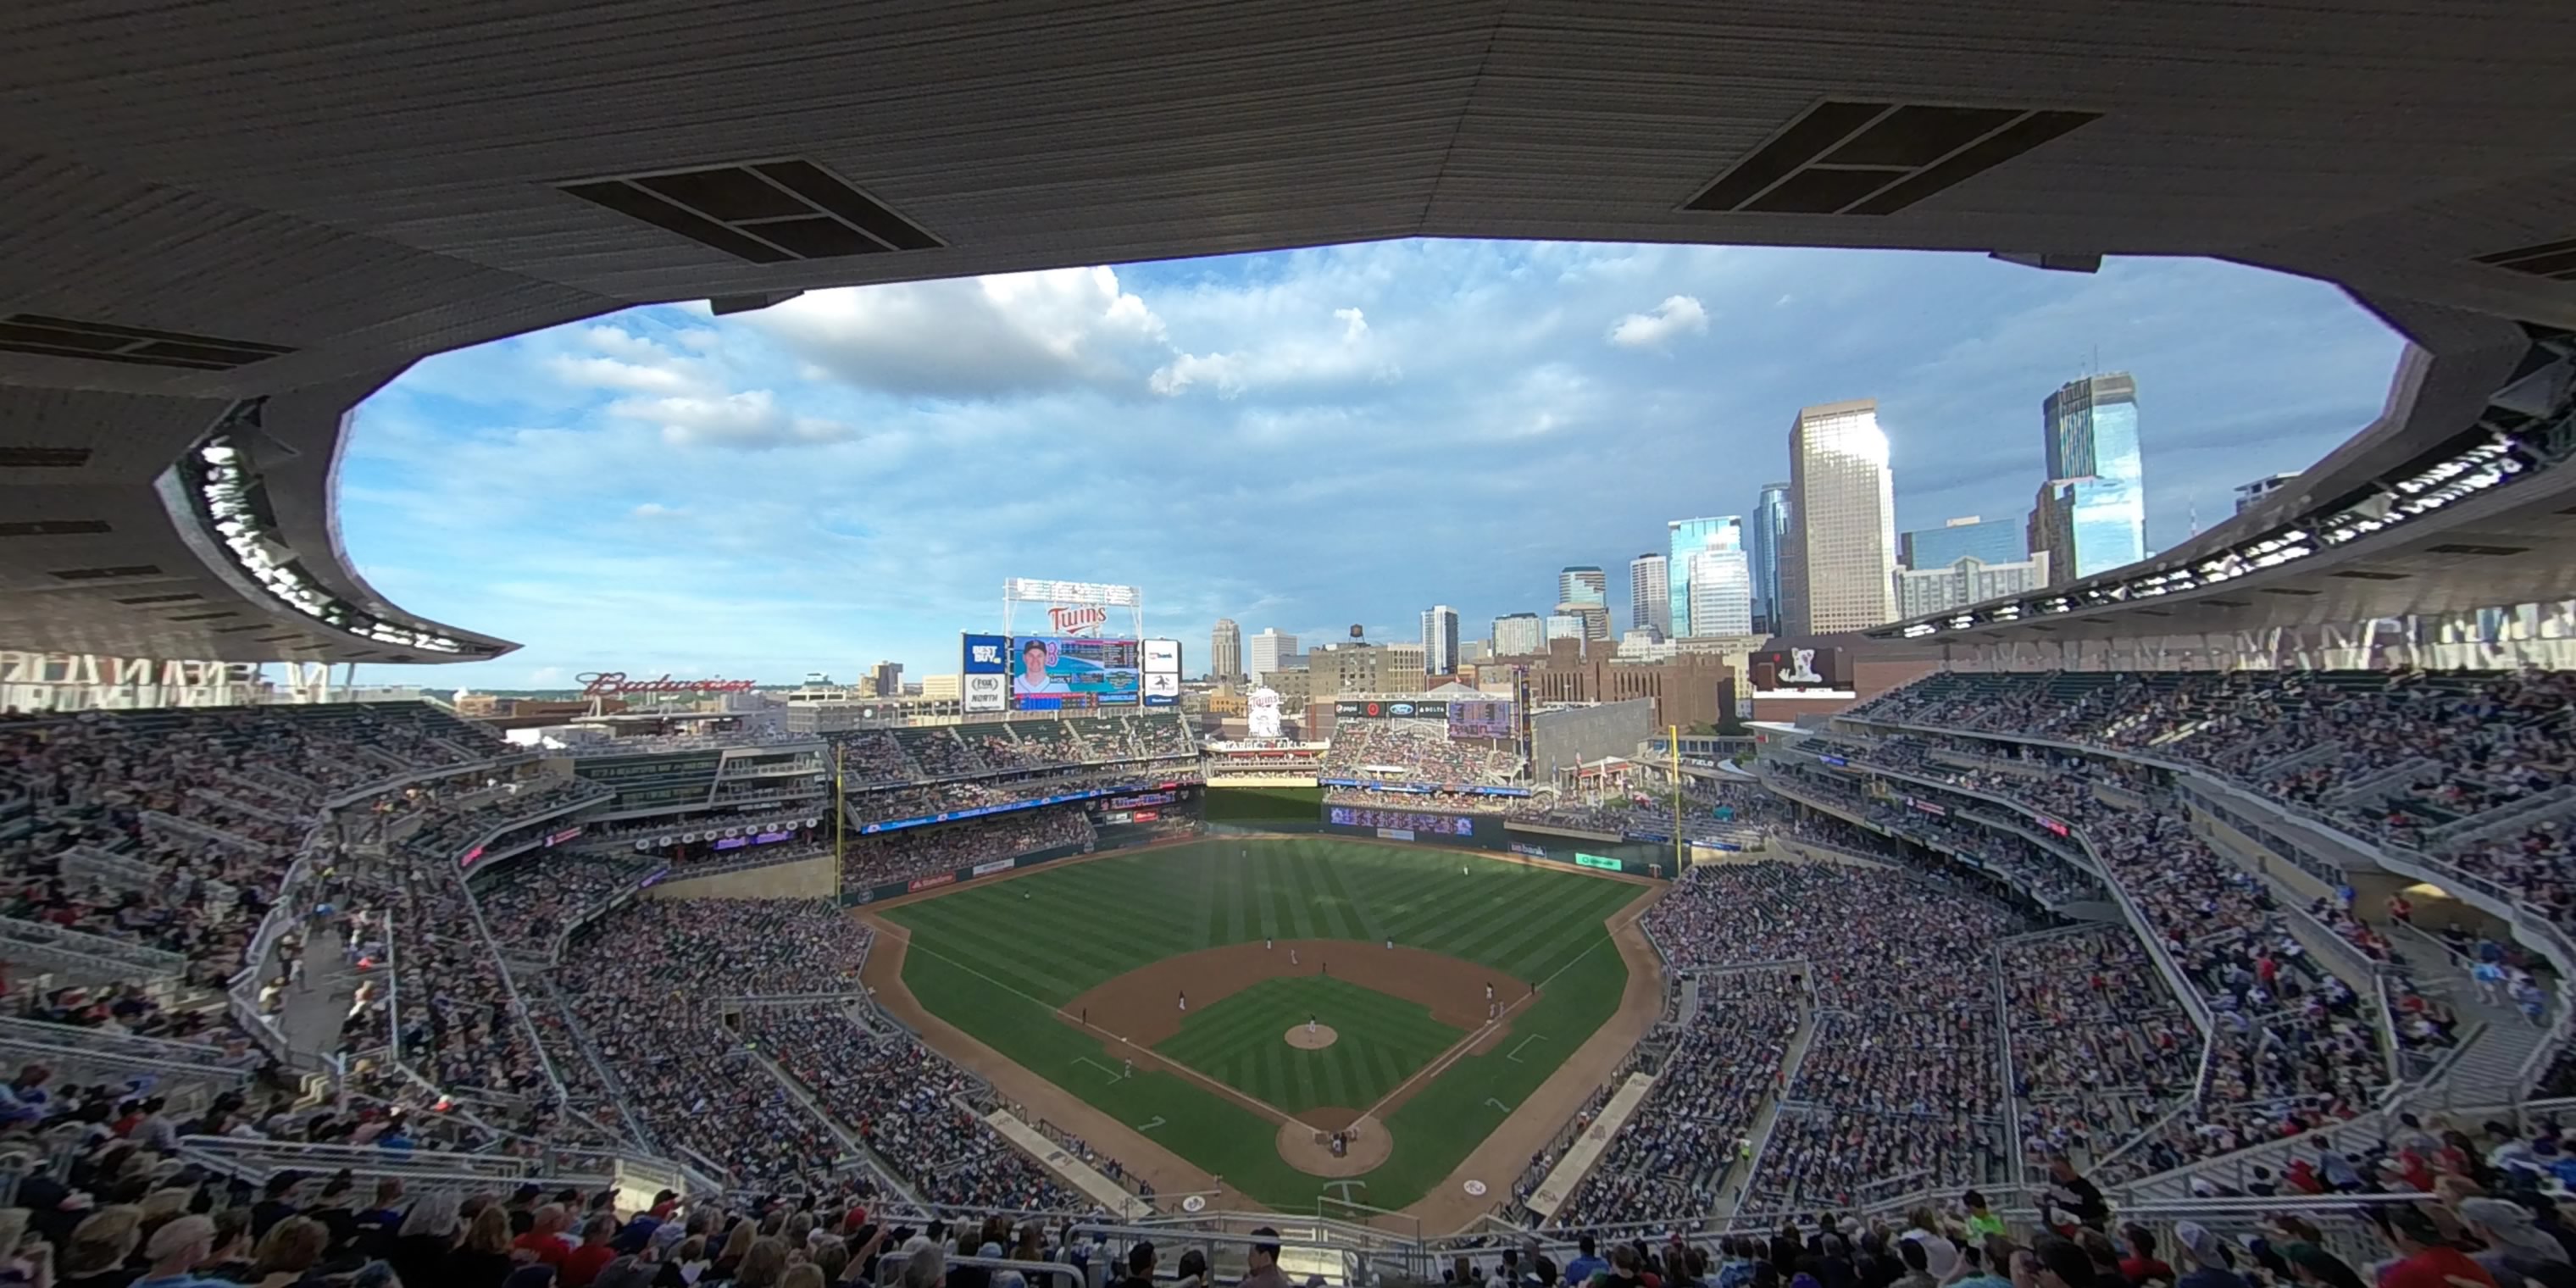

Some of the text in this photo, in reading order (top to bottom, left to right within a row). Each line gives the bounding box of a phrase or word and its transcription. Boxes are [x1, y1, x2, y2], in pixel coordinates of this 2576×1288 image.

[1047, 607, 1107, 633] Twins
[973, 646, 997, 654] BEST
[974, 652, 994, 662] BUY
[576, 672, 756, 696] Budweiser
[972, 694, 998, 702] NORTH
[1250, 695, 1278, 708] Twins
[1225, 739, 1309, 750] TARGET FIELD
[1691, 758, 1714, 767] FIELD
